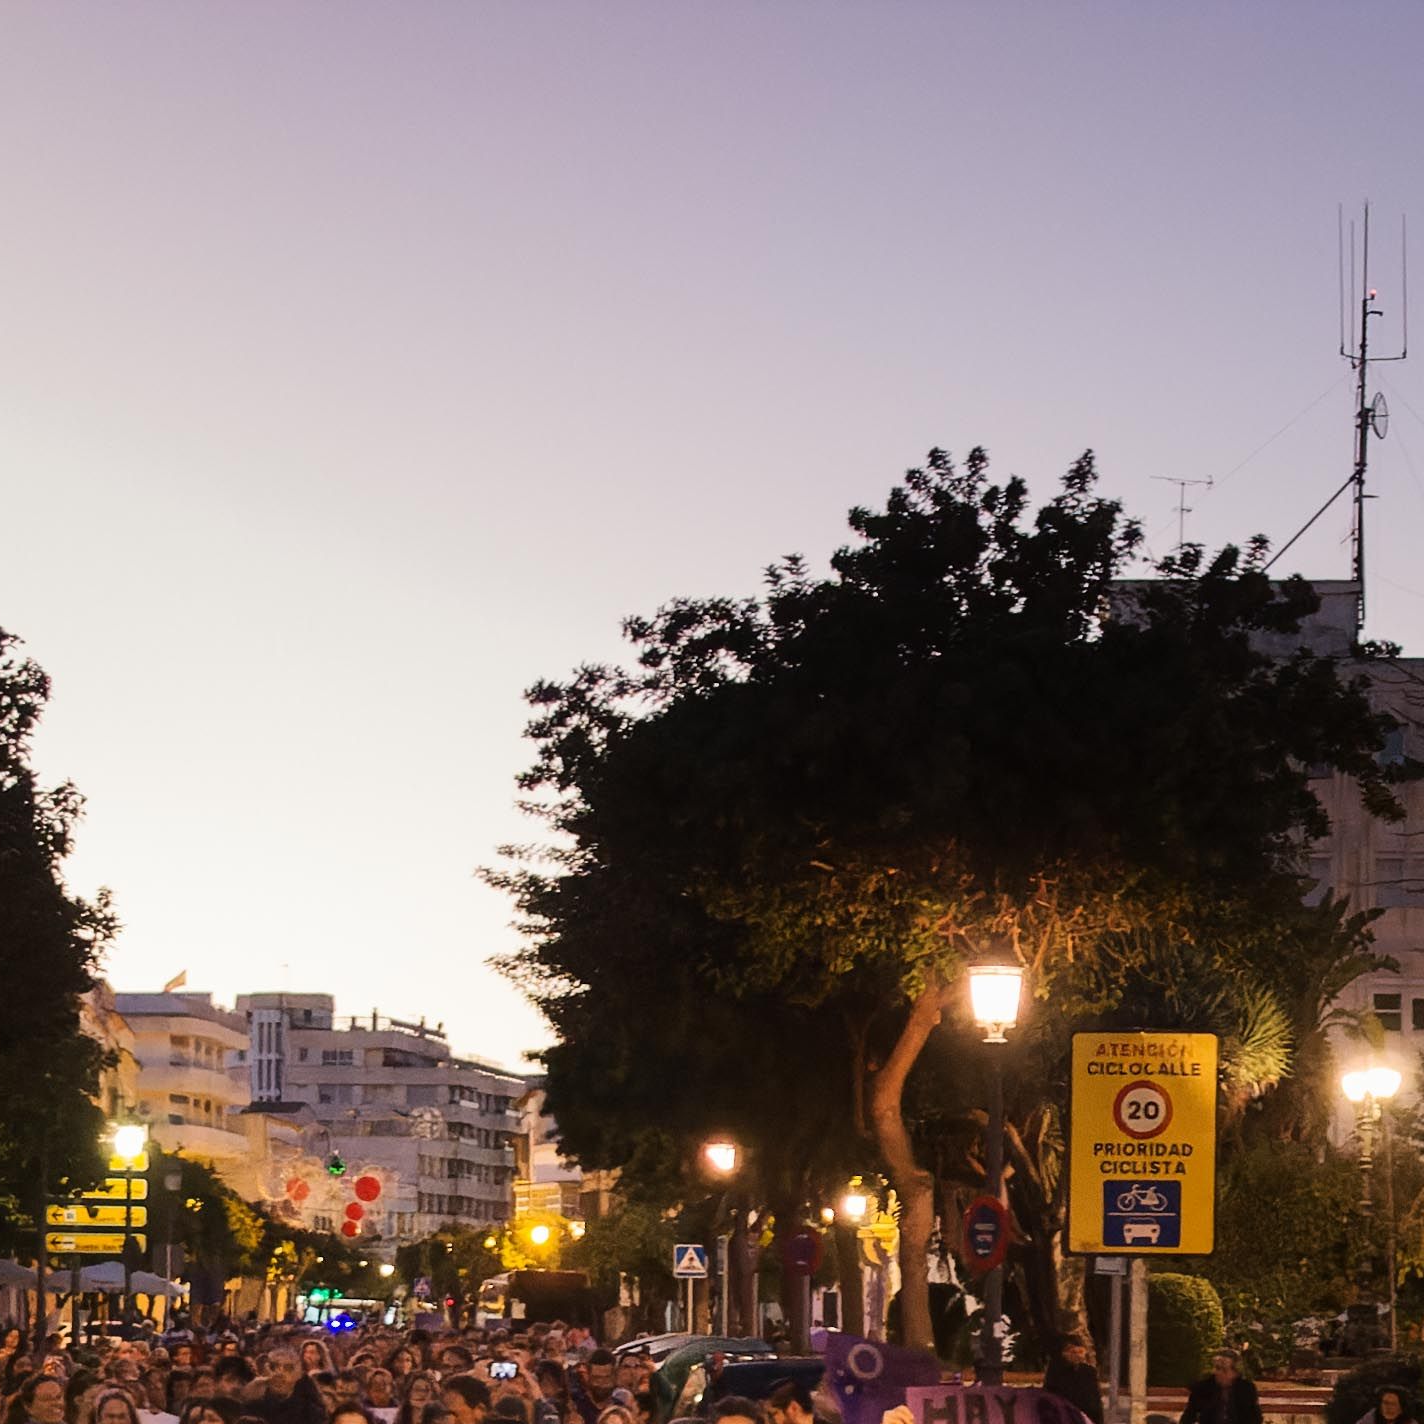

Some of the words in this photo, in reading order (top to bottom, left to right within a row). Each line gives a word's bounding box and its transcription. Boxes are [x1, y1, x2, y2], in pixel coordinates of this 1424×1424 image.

[1087, 1061, 1201, 1076] CICLOCALLE
[1127, 1101, 1160, 1120] 20
[1093, 1143, 1193, 1157] PRIORIDAD
[1099, 1161, 1187, 1175] CICLISTA
